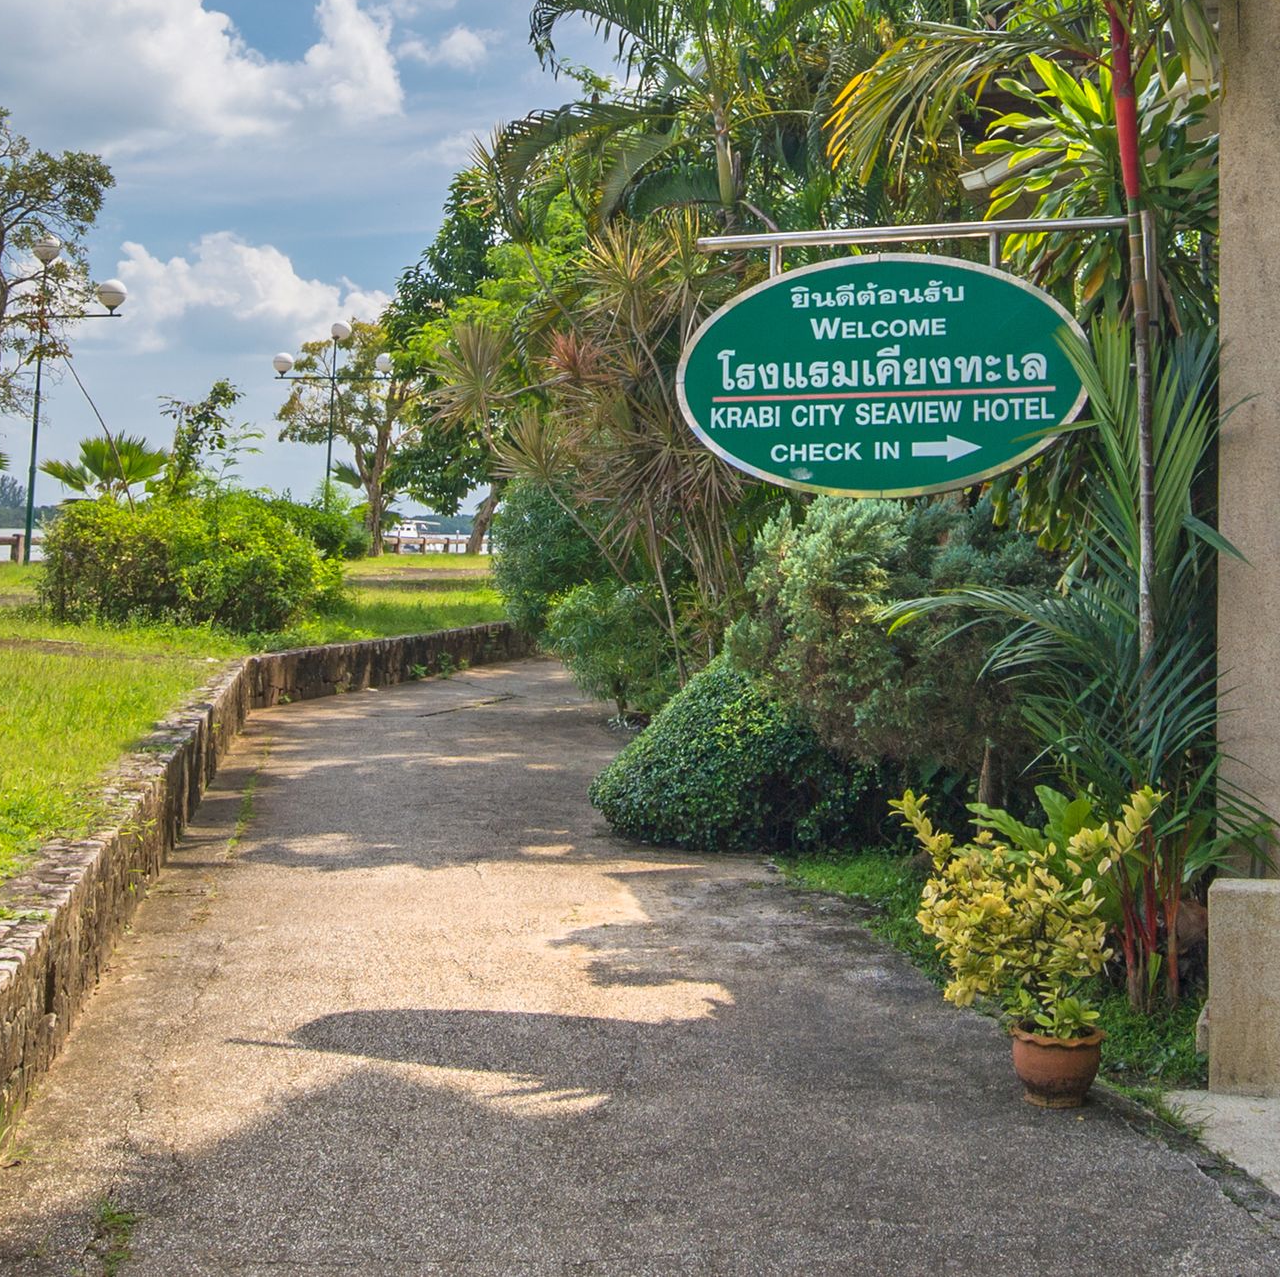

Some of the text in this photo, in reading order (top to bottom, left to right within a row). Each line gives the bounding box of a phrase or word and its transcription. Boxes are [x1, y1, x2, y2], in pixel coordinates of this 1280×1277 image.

[791, 280, 964, 308] ยินดีต้อนรับ
[810, 318, 946, 339] WELCOME
[718, 345, 1047, 390] โรงแรมเคียงทะเล
[711, 398, 1054, 428] KRABI CITY SEAVIEW HOTEL
[771, 442, 899, 462] CHECK IN
